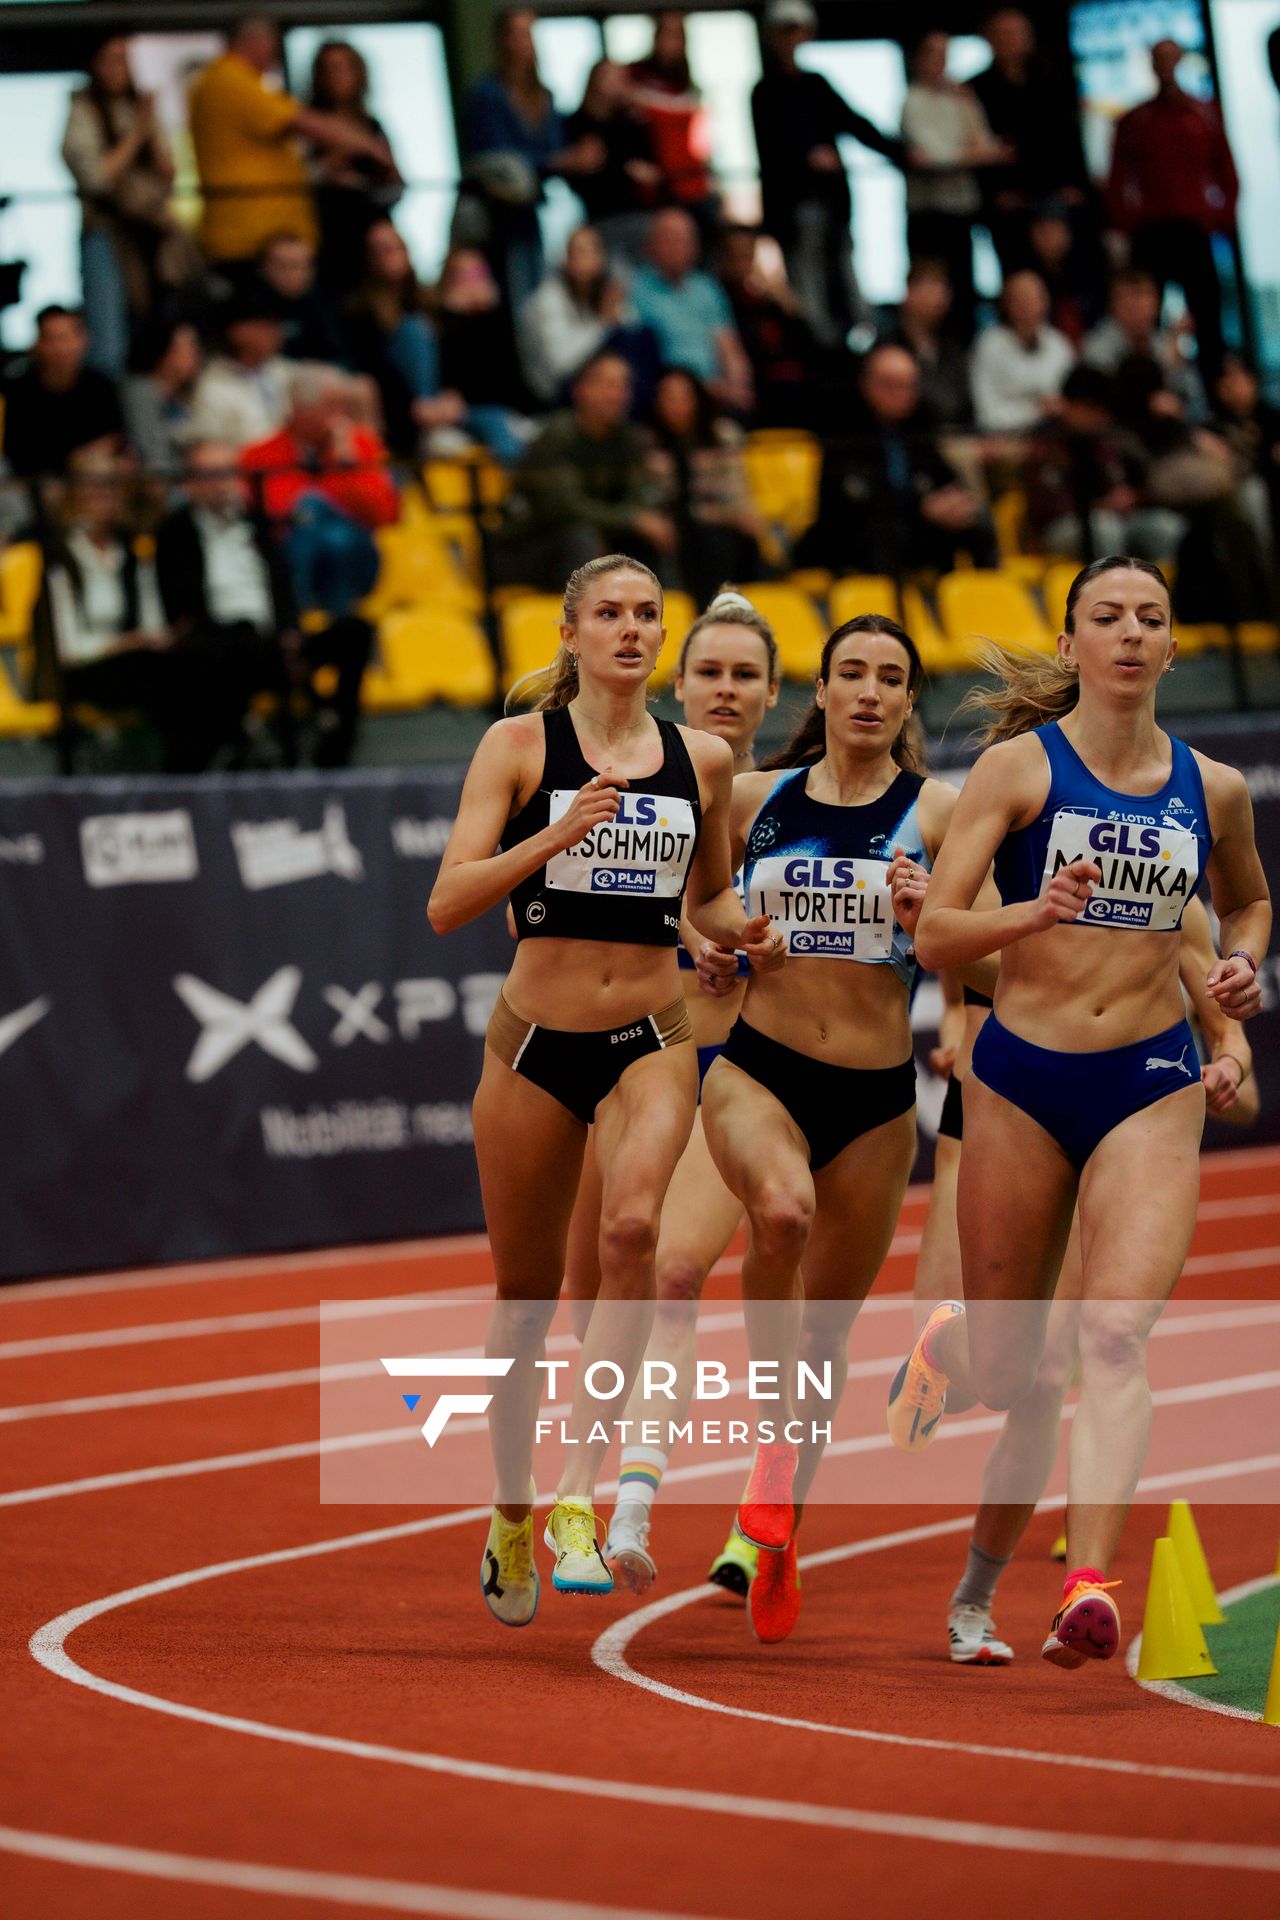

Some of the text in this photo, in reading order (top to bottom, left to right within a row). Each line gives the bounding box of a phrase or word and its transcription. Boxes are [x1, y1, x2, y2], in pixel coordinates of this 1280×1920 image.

[1121, 812, 1156, 826] LOTTO
[564, 827, 690, 863] .SCHMIDT
[617, 872, 654, 885] PLAN
[1112, 903, 1150, 918] PLAN
[816, 934, 852, 947] PLAN
[610, 1026, 643, 1044] BOSS
